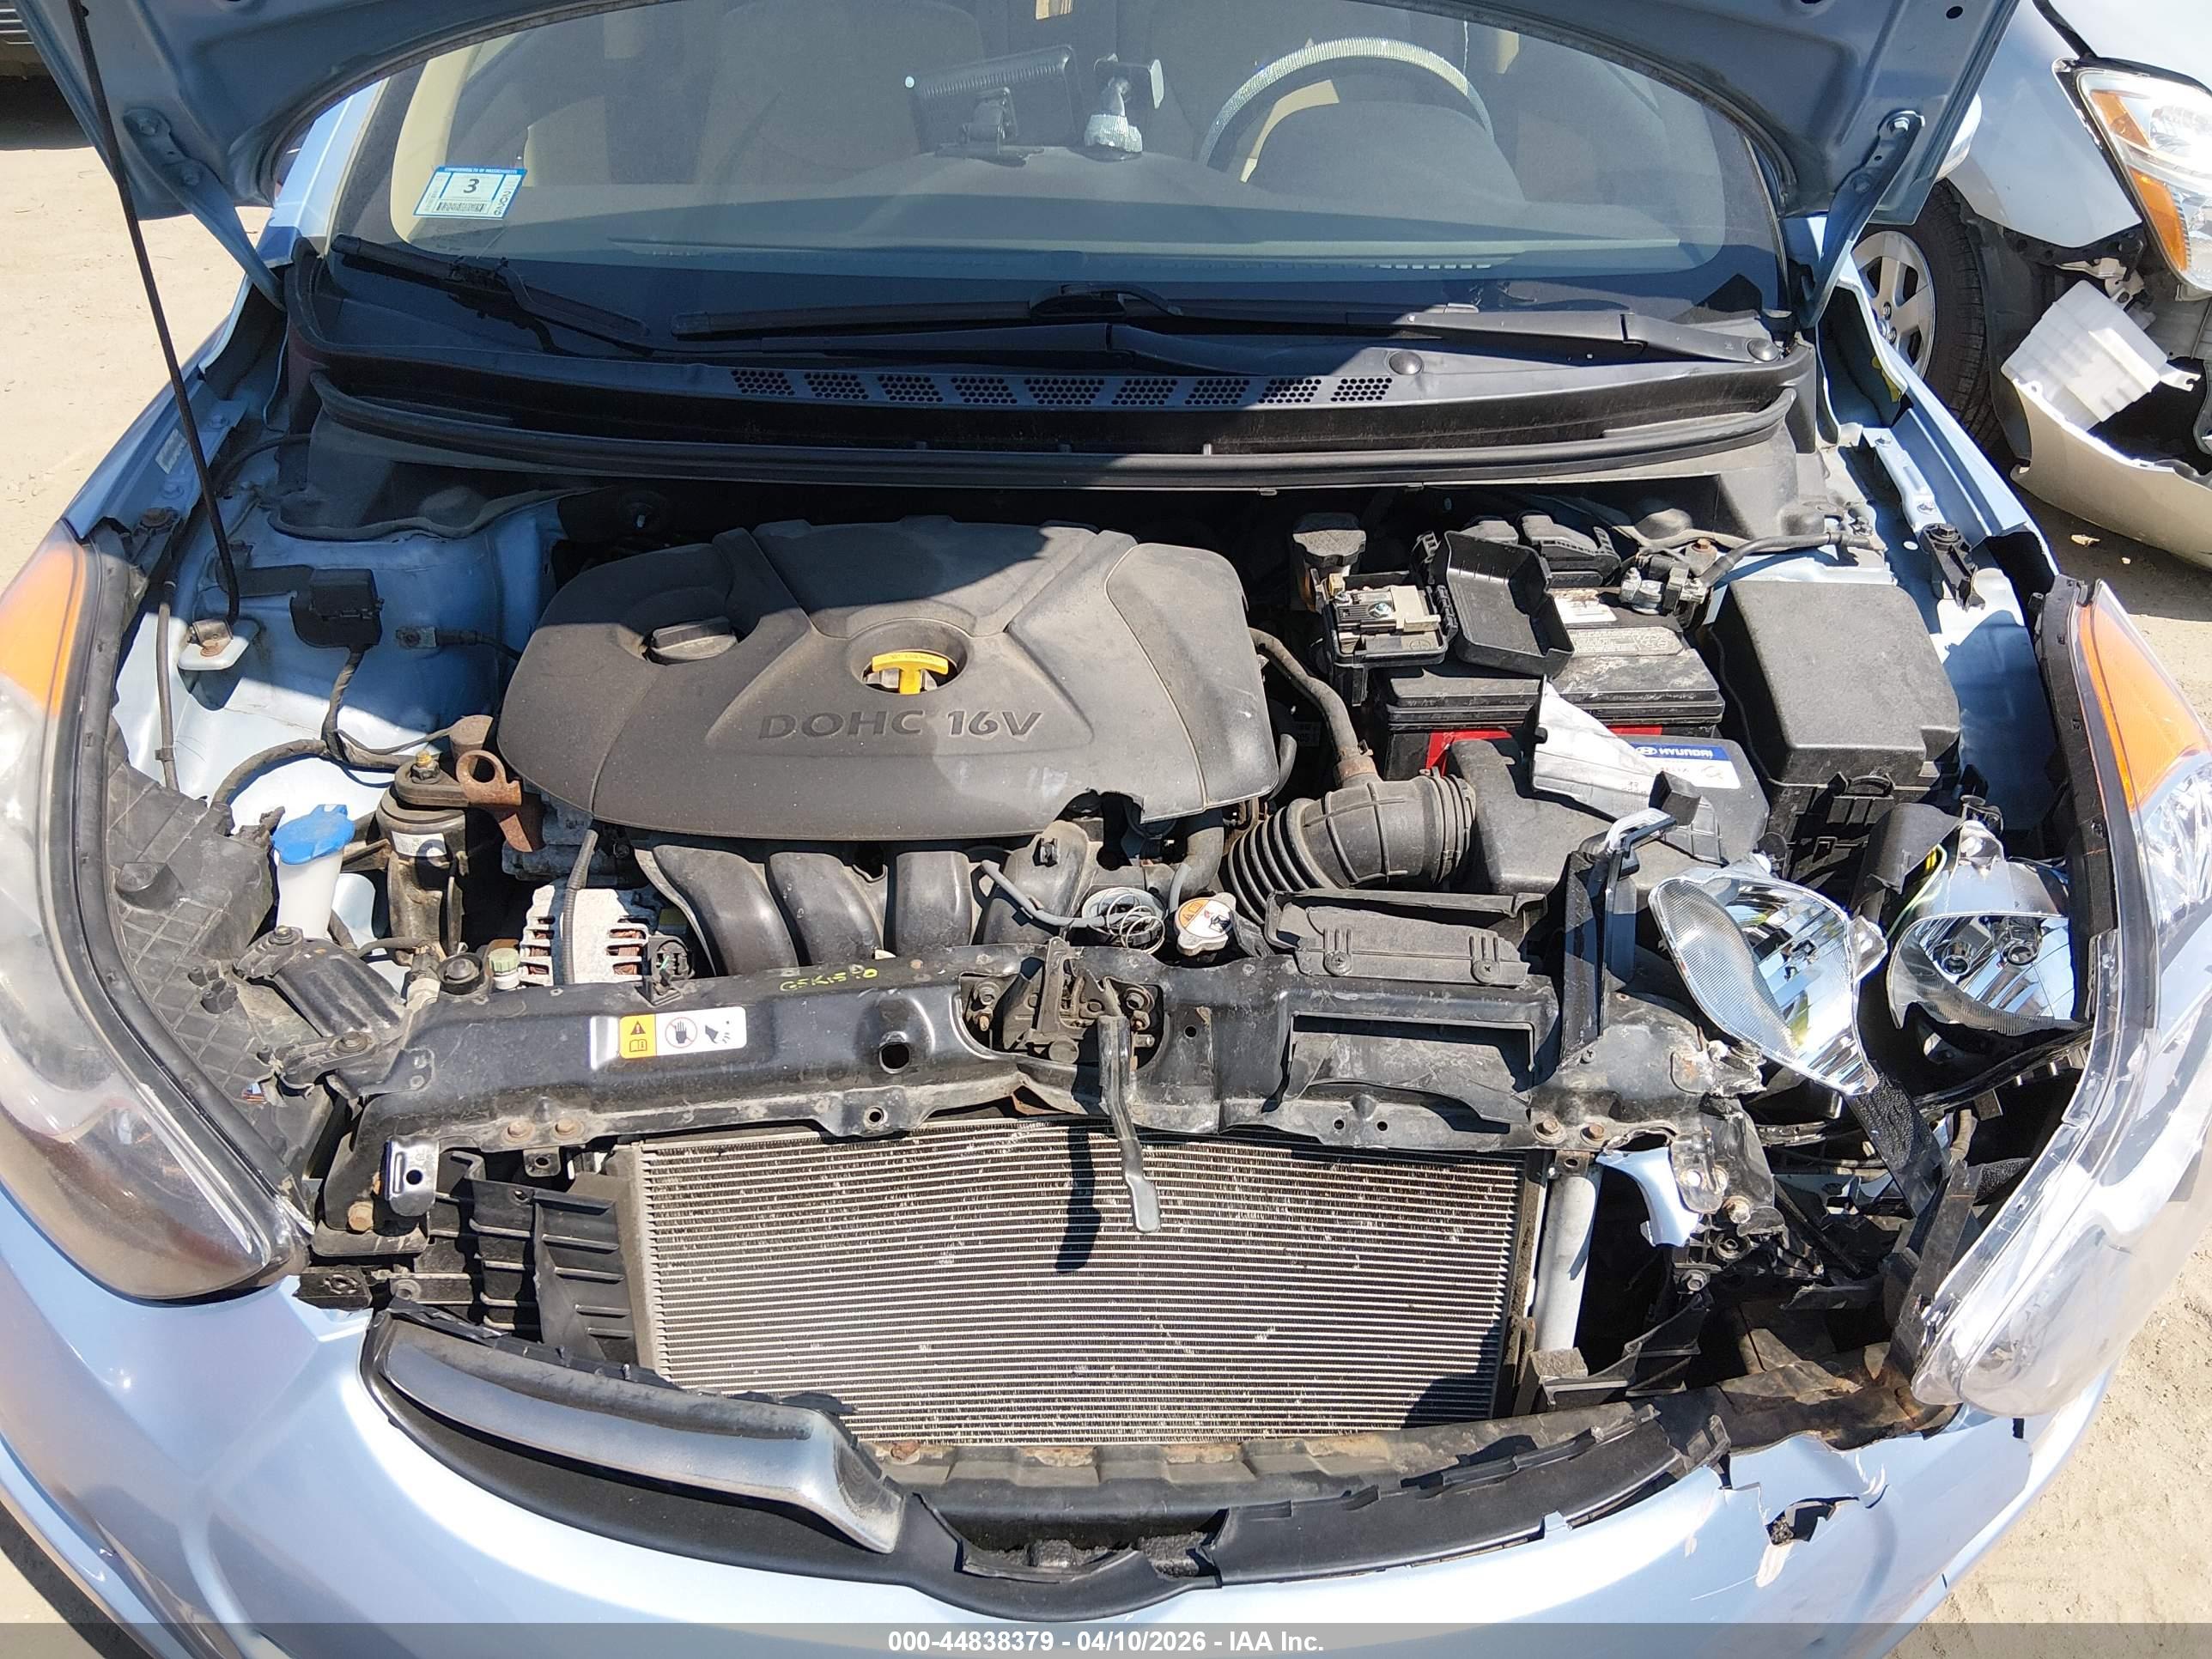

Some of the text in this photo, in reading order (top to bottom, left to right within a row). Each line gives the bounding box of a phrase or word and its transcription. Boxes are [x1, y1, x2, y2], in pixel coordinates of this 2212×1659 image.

[463, 178, 480, 193] 3
[494, 191, 511, 216] 2026
[759, 710, 1042, 739] DOHC 16V
[1658, 747, 1713, 759] HYUNDAI
